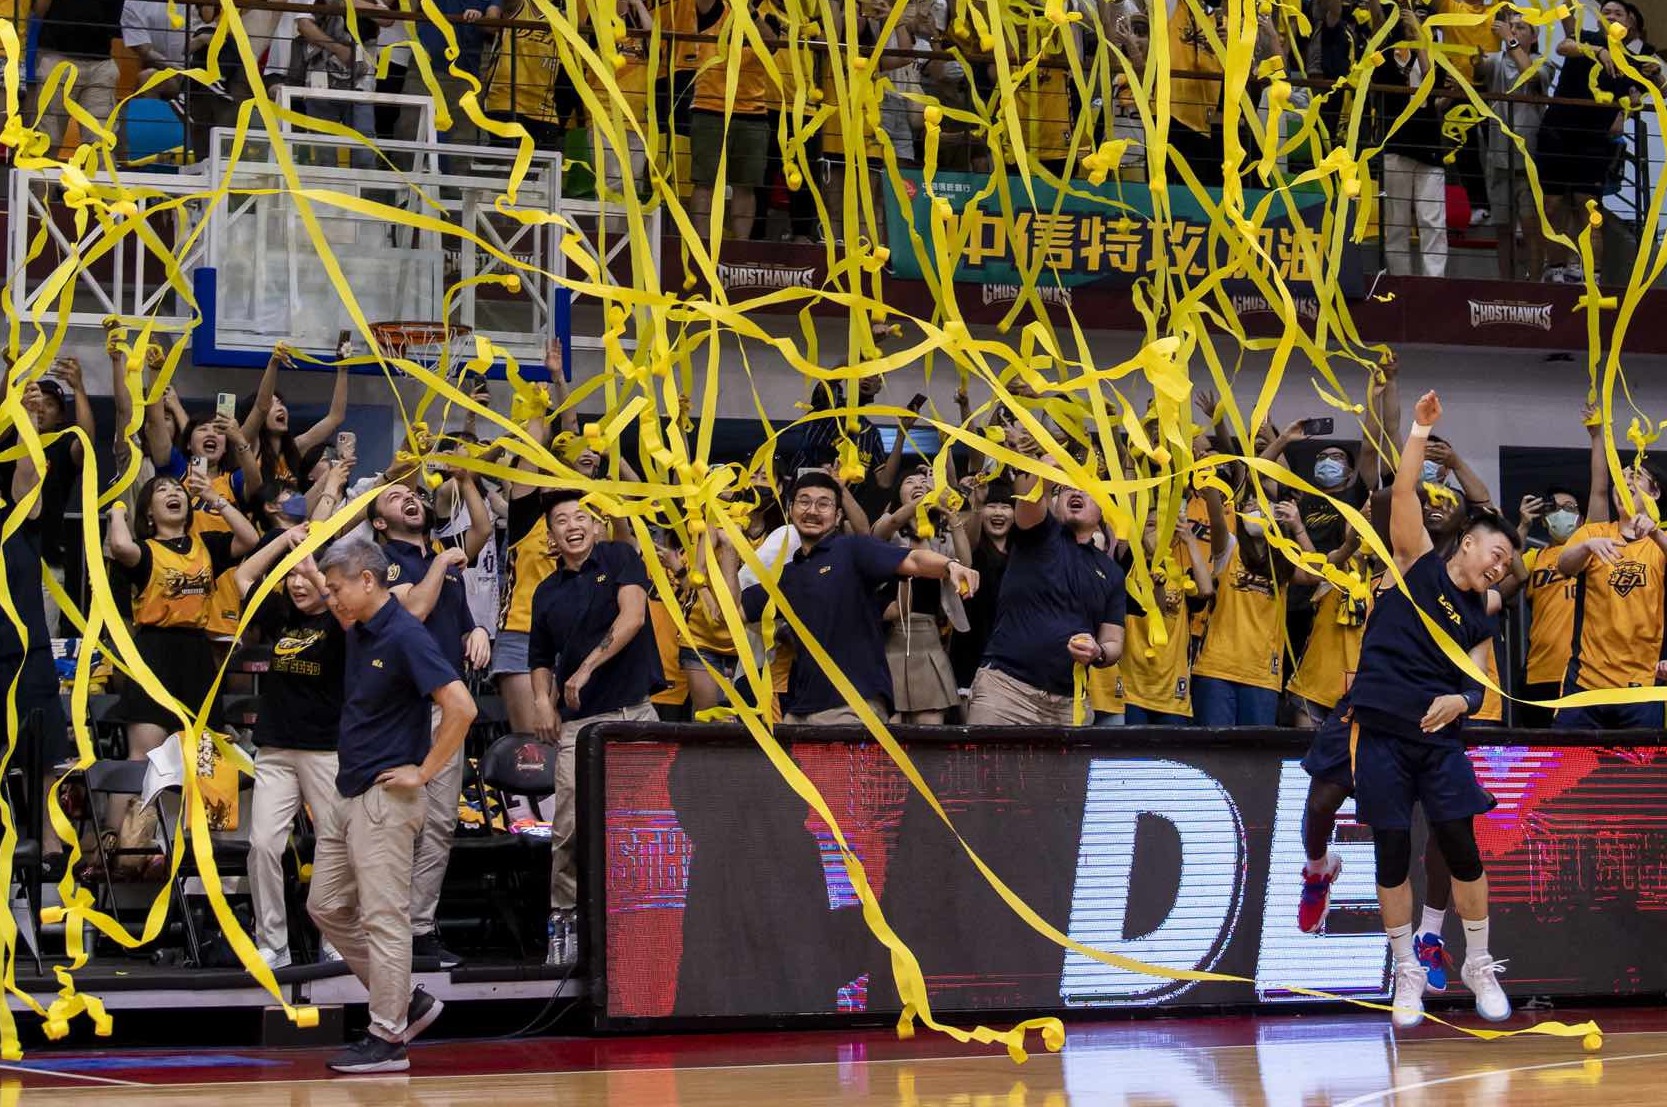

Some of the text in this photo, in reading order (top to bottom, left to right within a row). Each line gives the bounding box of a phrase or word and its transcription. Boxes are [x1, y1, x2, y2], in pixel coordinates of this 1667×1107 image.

[717, 263, 816, 290] GHOSTHAWKS
[982, 283, 1072, 306] GHOSAWKS
[1232, 295, 1318, 320] GHOSKS
[1467, 300, 1553, 331] GHOSTHAWKS
